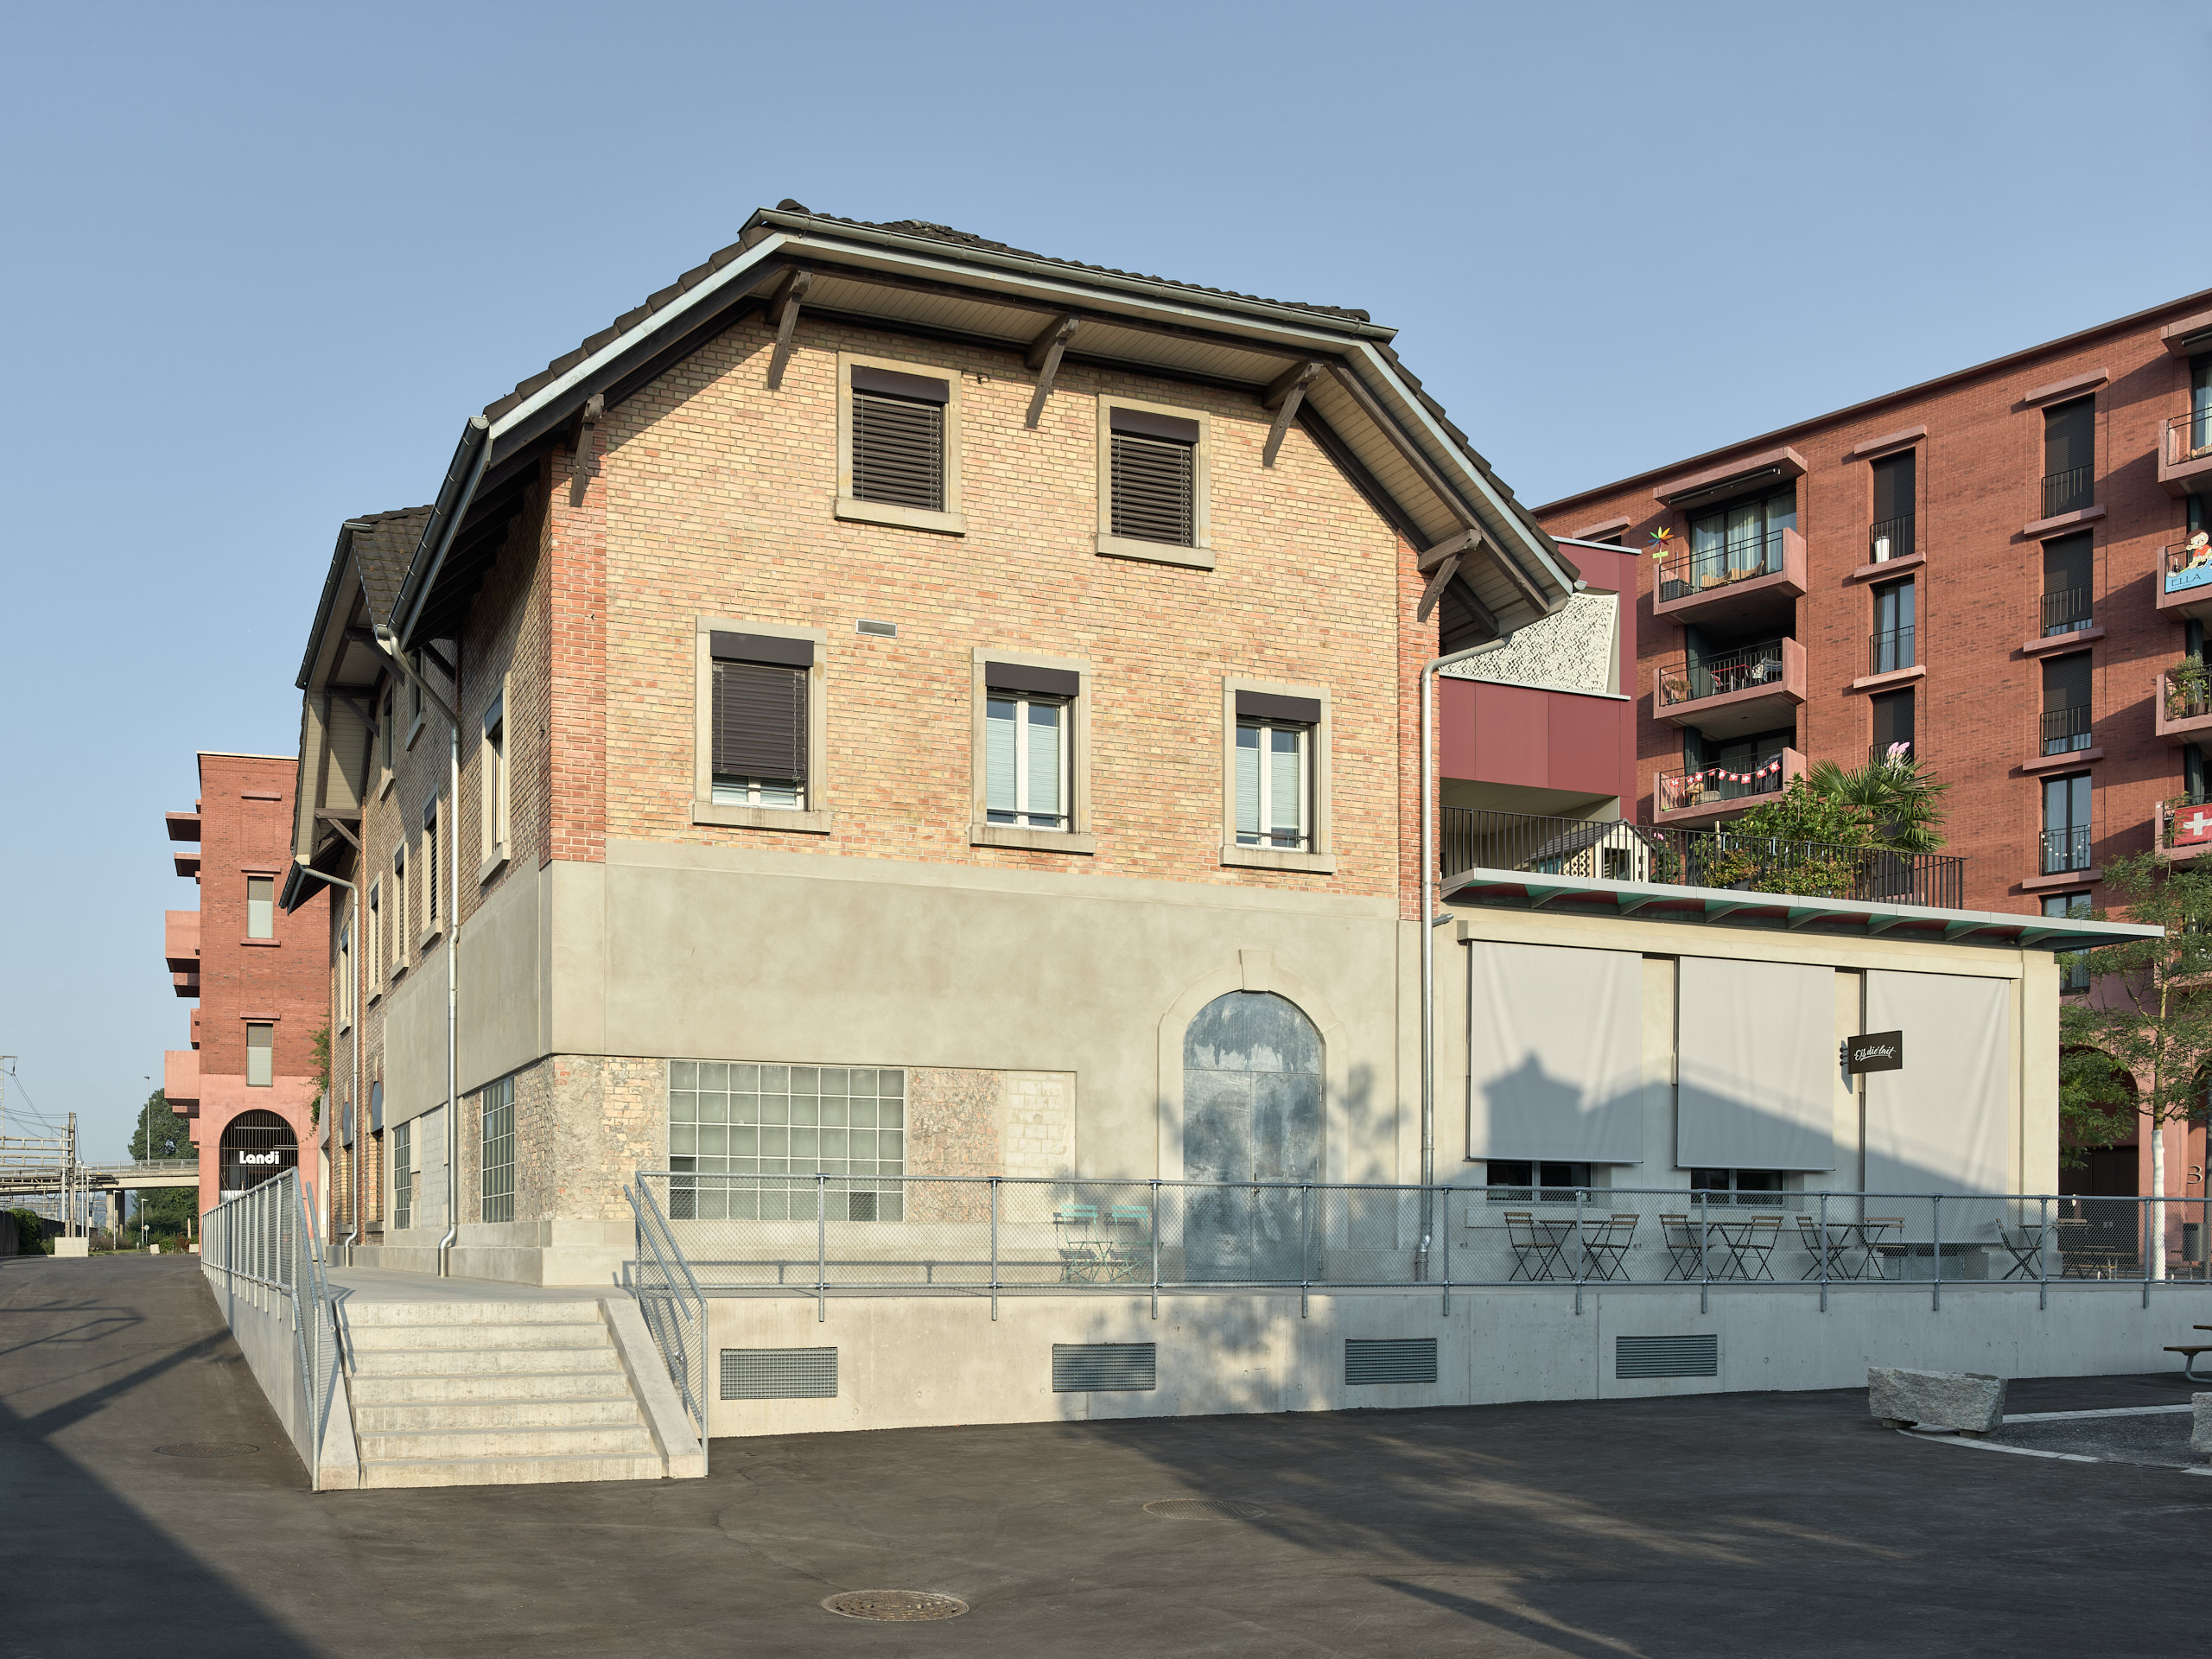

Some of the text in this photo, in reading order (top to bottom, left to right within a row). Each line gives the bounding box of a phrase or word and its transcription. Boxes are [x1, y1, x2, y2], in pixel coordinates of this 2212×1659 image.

[2171, 574, 2201, 586] ELLA
[239, 1151, 279, 1164] Landi
[2187, 1166, 2202, 1184] 3
